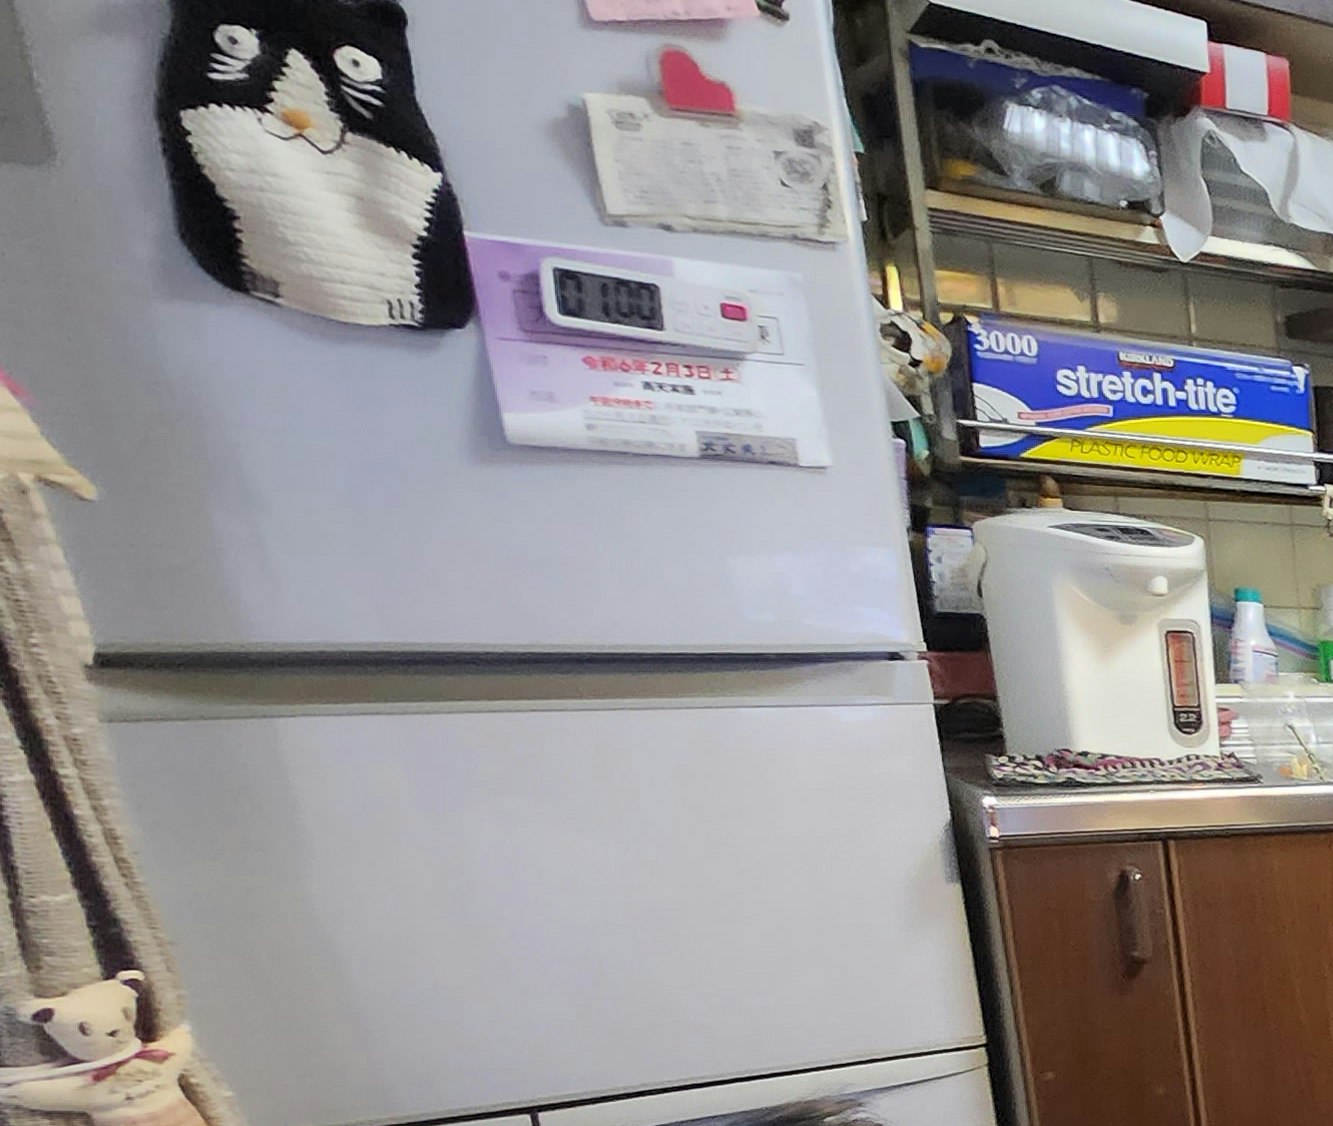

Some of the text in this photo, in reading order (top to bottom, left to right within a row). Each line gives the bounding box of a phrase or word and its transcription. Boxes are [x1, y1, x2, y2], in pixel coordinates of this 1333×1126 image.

[973, 328, 1039, 357] 3000
[1056, 365, 1238, 414] stretch-tite
[1070, 438, 1242, 469] PLASTIC FOOD WRAP
